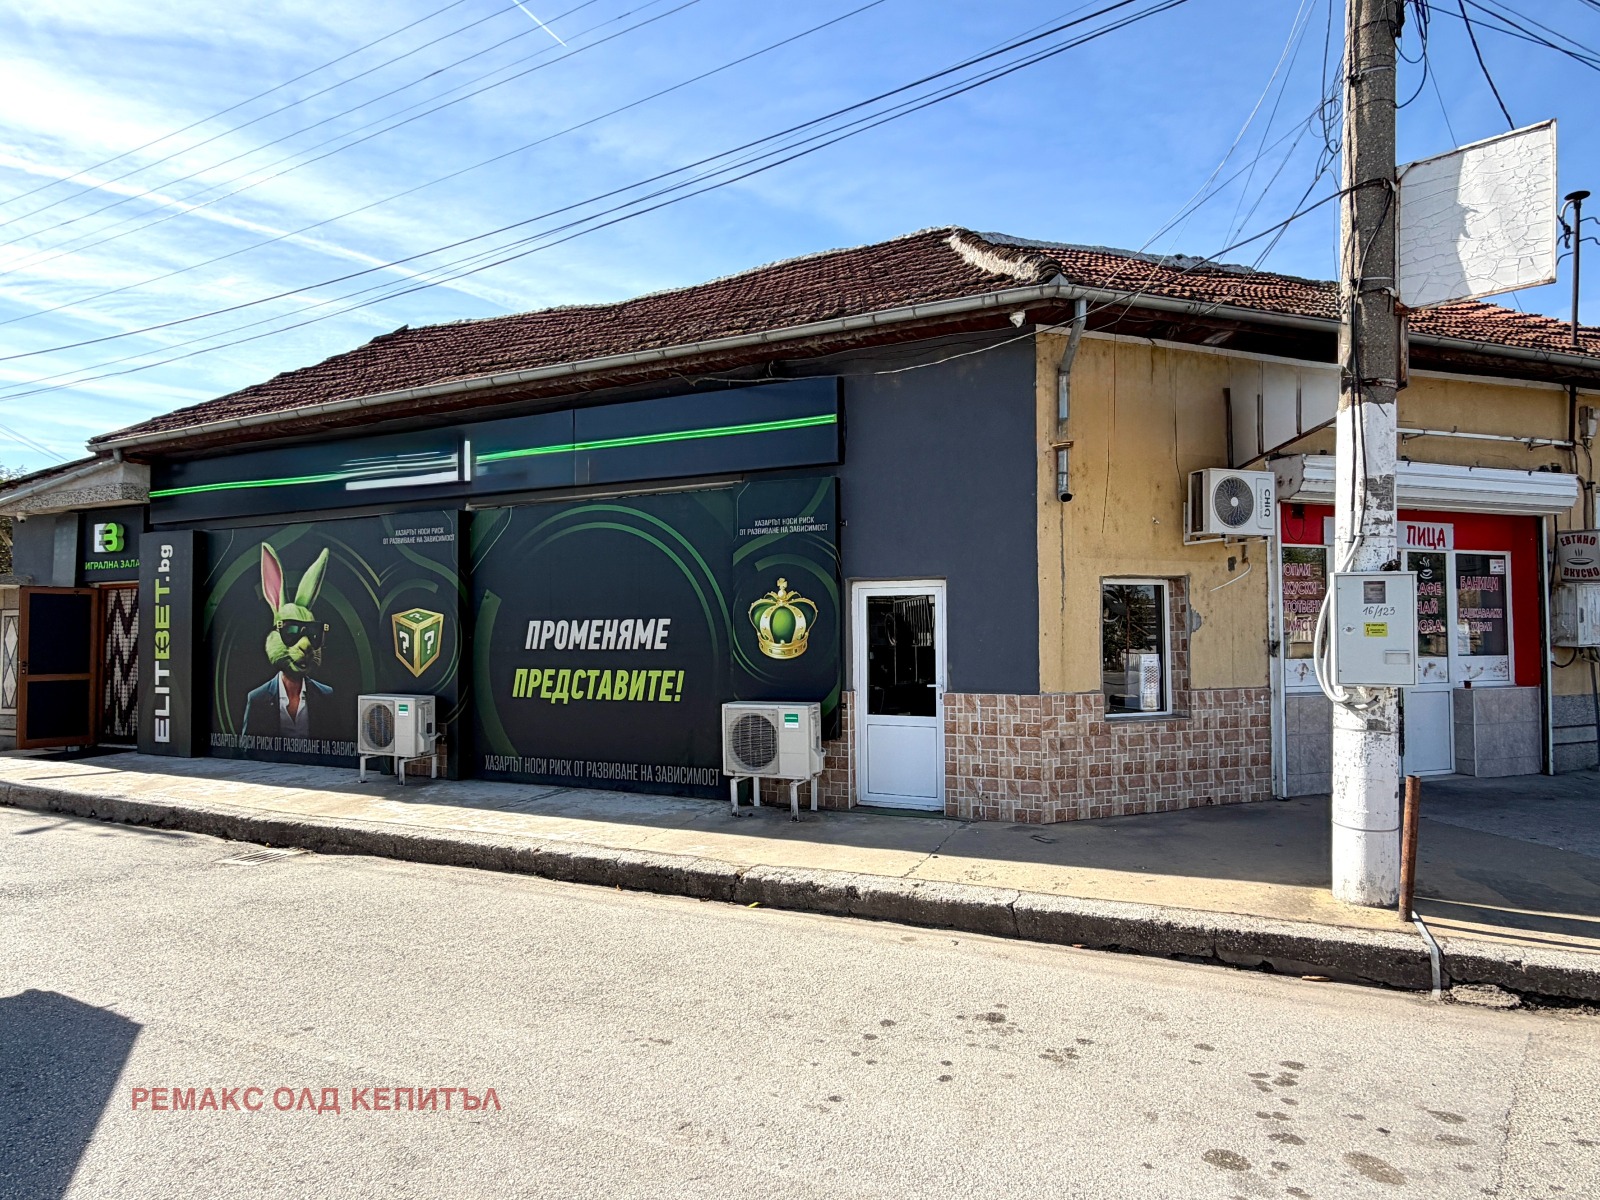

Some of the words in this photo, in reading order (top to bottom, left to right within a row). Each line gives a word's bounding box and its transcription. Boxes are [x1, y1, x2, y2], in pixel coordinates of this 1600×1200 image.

[754, 519, 780, 527] ХАЗАРТЪТ
[798, 516, 815, 524] РИСК
[747, 527, 779, 535] РАЗВИВАНЕ
[789, 524, 828, 533] ЗАВИСИМОСТ
[1407, 525, 1446, 550] ПИЦА
[1560, 535, 1596, 546] ЕВТИНО
[85, 561, 118, 570] ИГРАЛНА
[120, 559, 140, 569] ЗАЛА
[1283, 563, 1311, 576] ОПЛИ
[1564, 567, 1600, 578] ВКУСНО
[1460, 576, 1499, 592] БАНИЦИ
[1363, 605, 1396, 619] 16/123
[1417, 620, 1442, 632] ОЗА
[525, 618, 671, 650] ПРОМЕНЯМЕ
[512, 668, 685, 704] ПРЕДСТАВИТЕ!
[211, 733, 238, 747] ХАЗАРТЪТ
[239, 734, 255, 749] НОСИ
[256, 736, 273, 750] РИСК
[274, 737, 282, 751] ОТ
[283, 737, 320, 754] РАЗВИВАНЕ
[321, 741, 331, 755] НА
[485, 755, 523, 773] ХАЗАРТЪТ
[524, 757, 547, 775] НОСИ
[549, 759, 572, 776] РИСК
[574, 760, 584, 777] ОТ
[586, 761, 638, 781] РАЗВИВАНЕ
[640, 764, 653, 782] НА
[655, 765, 719, 786] ЗАВИСИМОСТ
